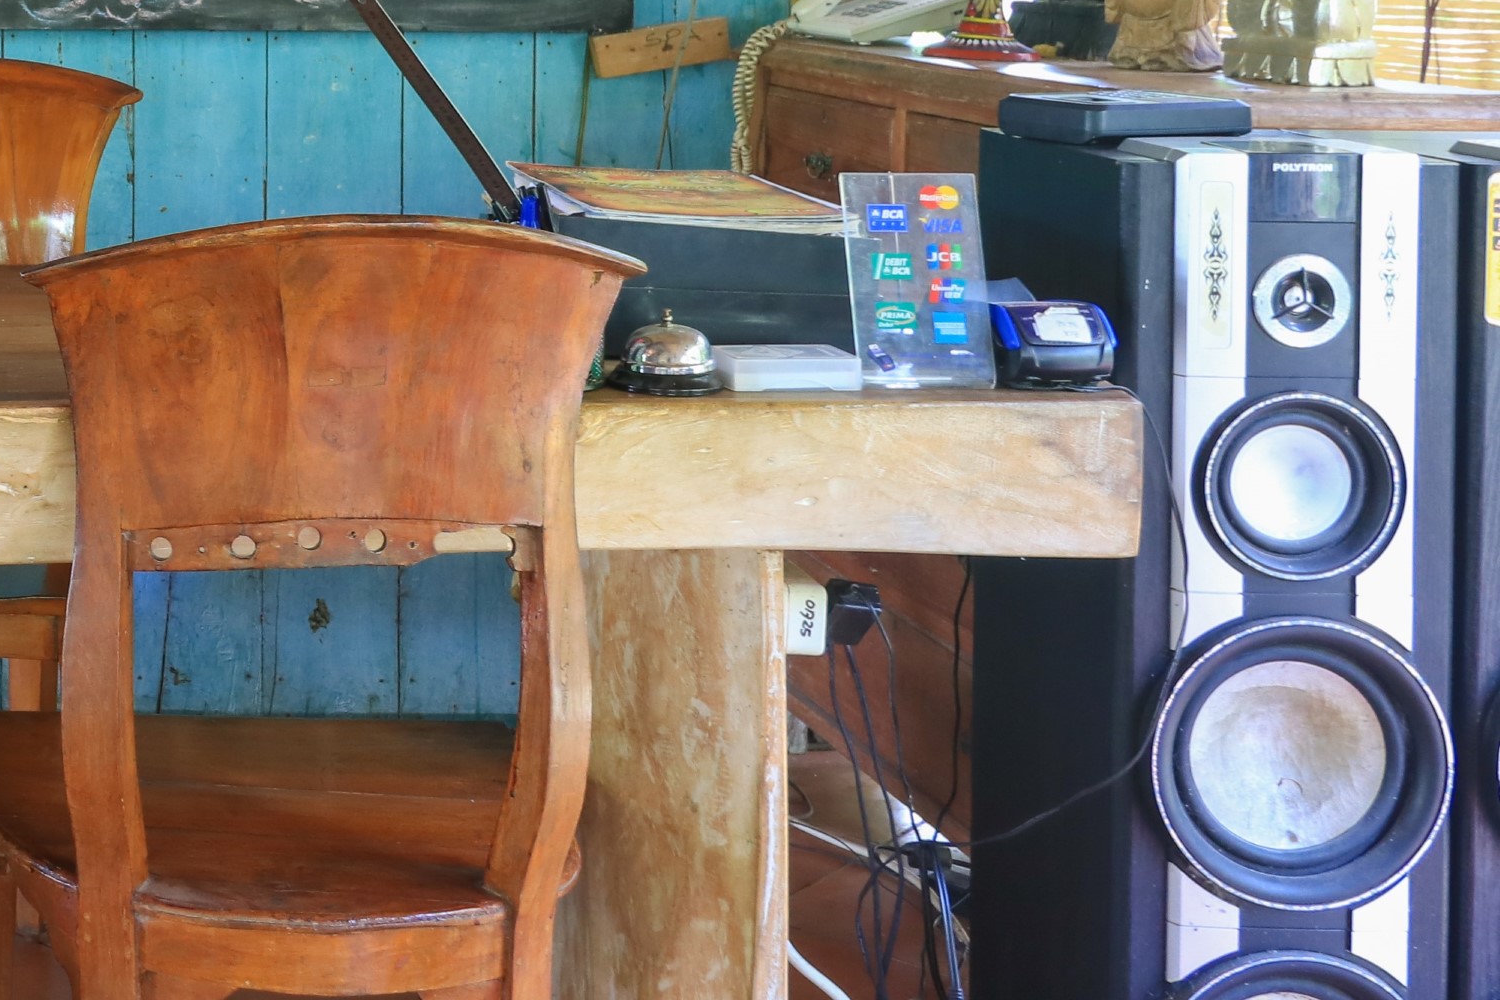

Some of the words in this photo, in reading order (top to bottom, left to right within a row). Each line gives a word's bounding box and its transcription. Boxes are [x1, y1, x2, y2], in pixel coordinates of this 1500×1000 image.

[1272, 162, 1333, 172] POLYTRON
[882, 209, 904, 219] BCA
[922, 218, 964, 233] VISA
[884, 257, 908, 267] DEBIT
[926, 252, 961, 262] JCB
[891, 267, 911, 275] BCA
[880, 311, 912, 320] PRIMA
